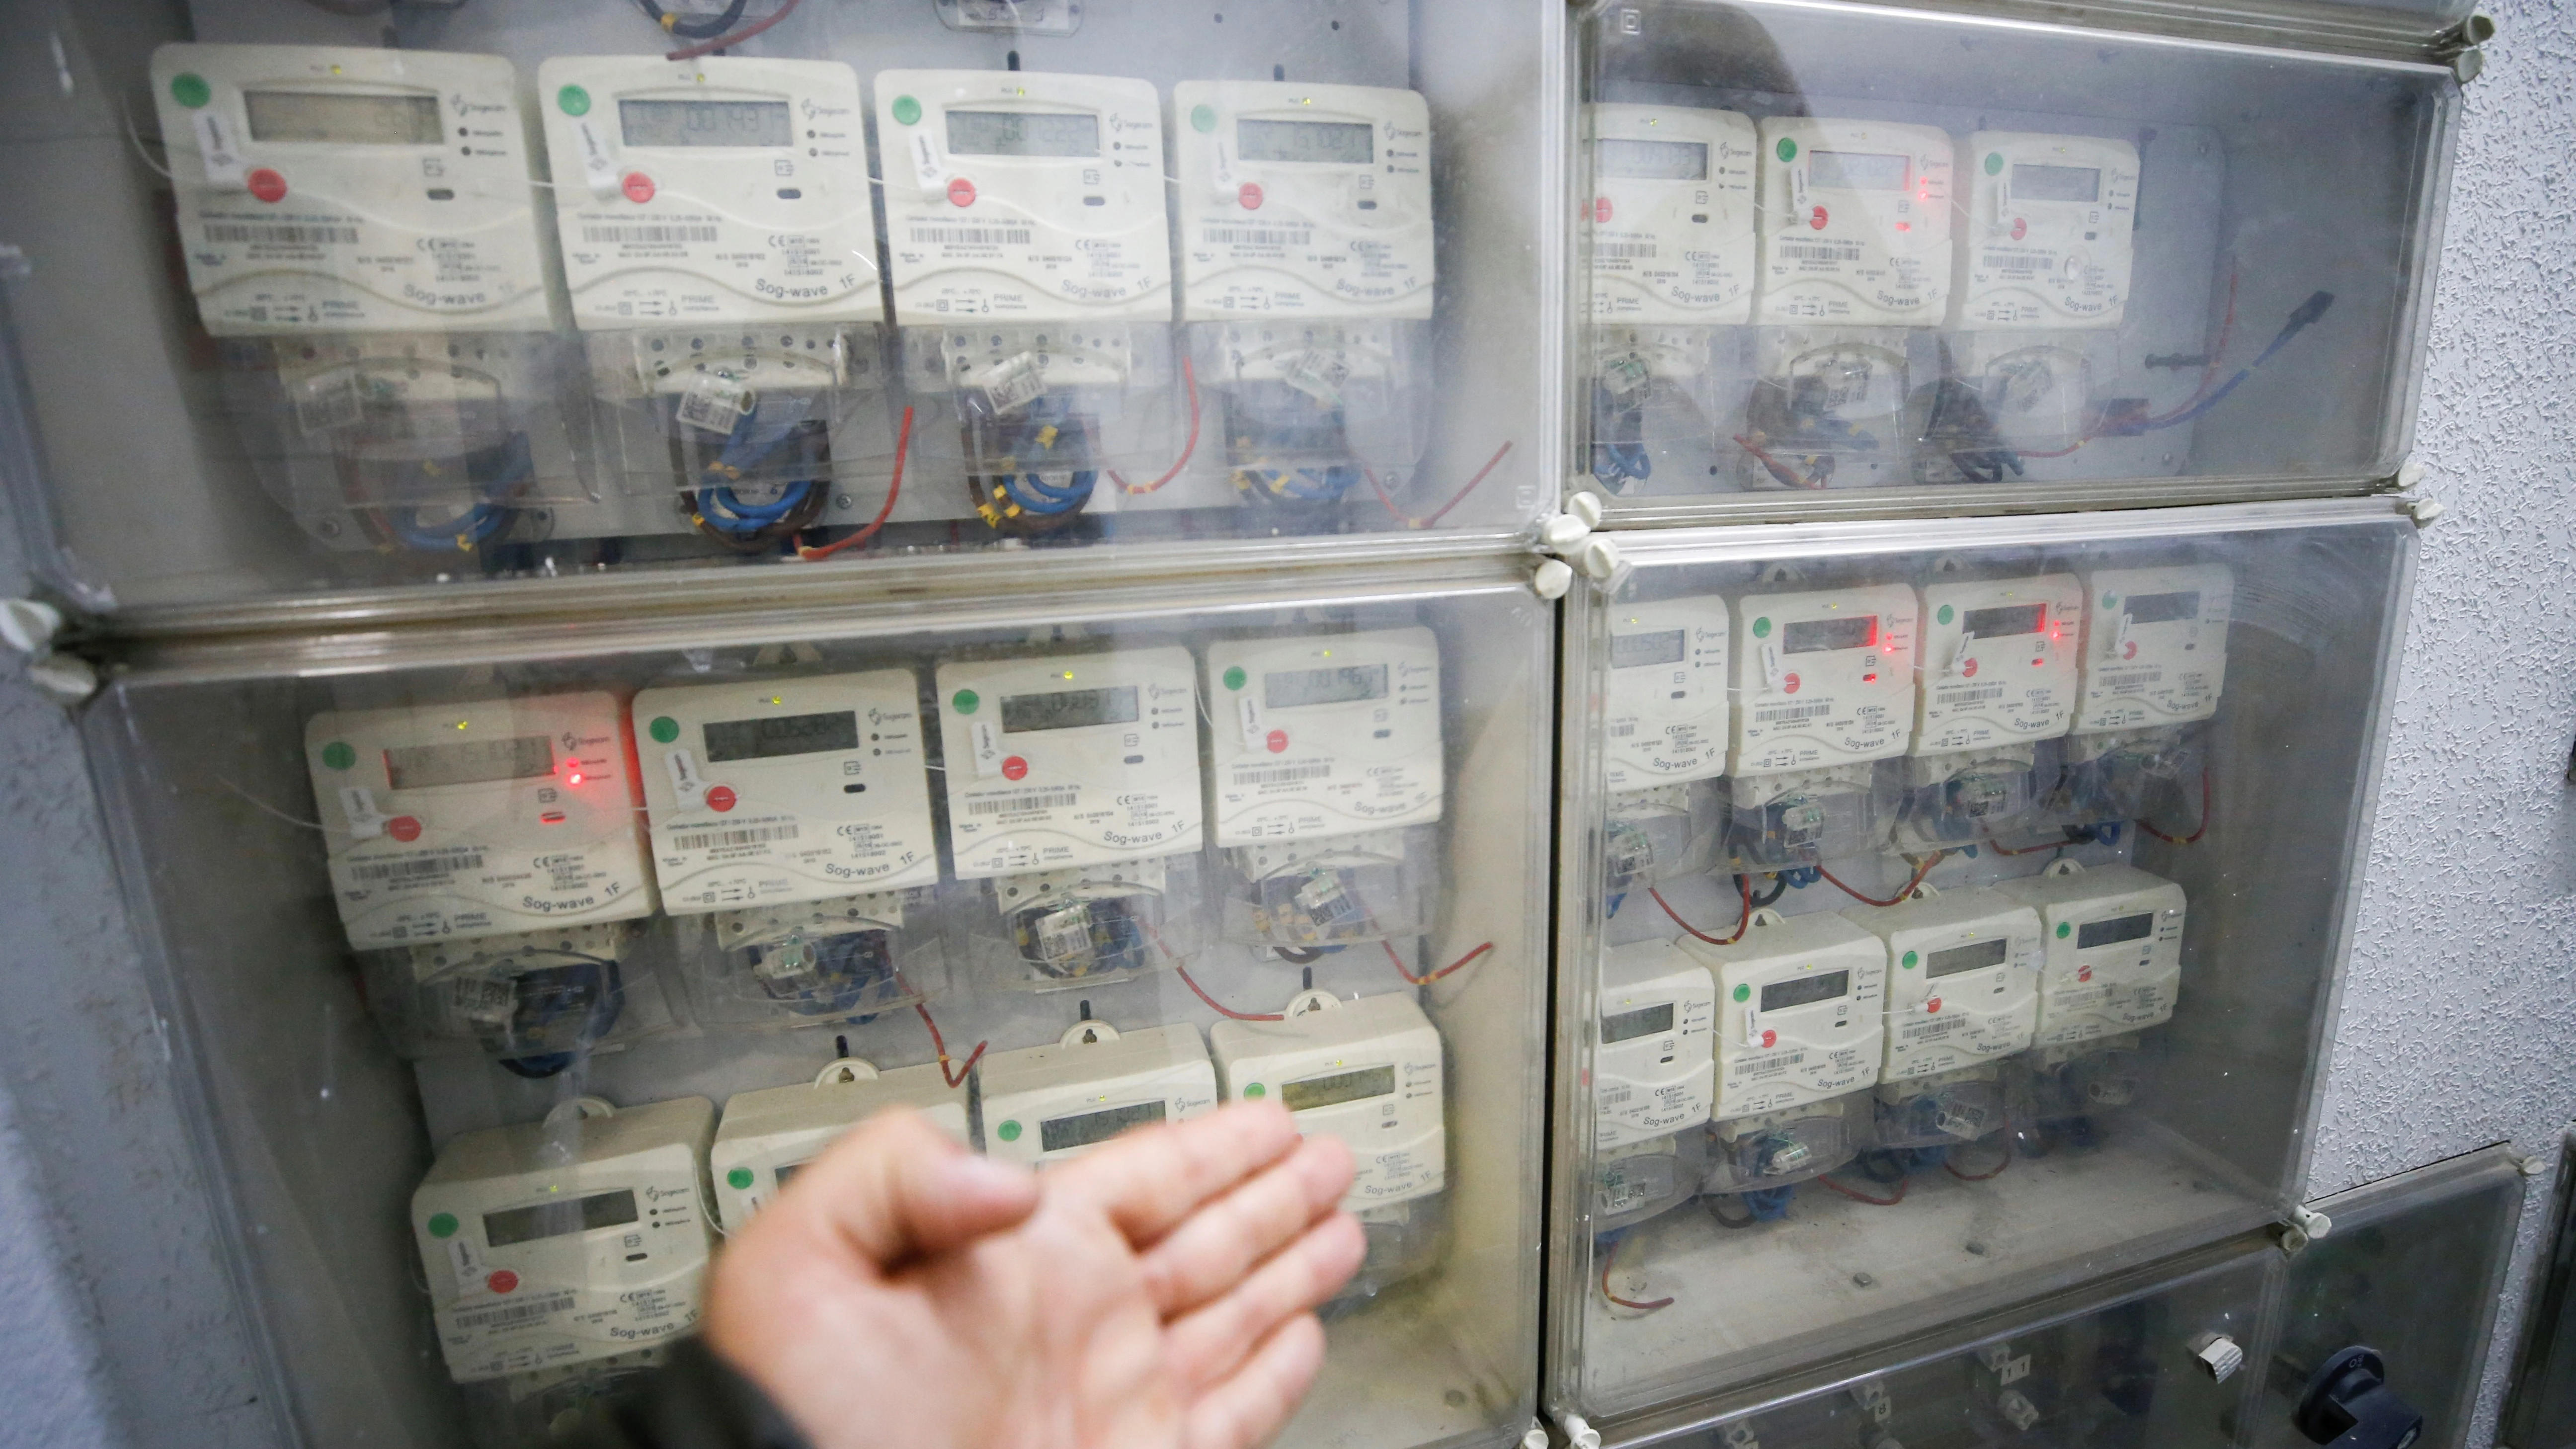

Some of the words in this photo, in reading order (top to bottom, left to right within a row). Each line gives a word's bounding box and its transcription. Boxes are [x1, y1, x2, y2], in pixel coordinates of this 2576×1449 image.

[403, 284, 486, 306] Sog-wave
[756, 278, 828, 298] Sog-wave
[839, 274, 856, 289] 1F
[1062, 279, 1126, 299] Sog-wave
[1137, 277, 1151, 290] 1F
[1336, 278, 1395, 297] Sog-wave
[1404, 277, 1417, 289] 1F
[1671, 286, 1720, 304] Sog-wave
[1728, 285, 1739, 296] 1F
[1877, 290, 1920, 306] Sog-wave
[1927, 288, 1938, 300] 1F
[2065, 296, 2101, 312] Sog-wave
[2109, 295, 2117, 306] 1F
[2167, 699, 2199, 711] Sog-wave
[2014, 718, 2049, 730] Sog-wave
[2056, 711, 2064, 721] 1F
[1845, 737, 1884, 750] Sog-wave
[1891, 729, 1901, 740] 1F
[1653, 757, 1697, 771] Sog-wave
[1705, 748, 1716, 759] 1F
[1355, 802, 1406, 815] Sog-wave
[1104, 831, 1162, 846] Sog-wave
[1171, 820, 1185, 832] 1F
[826, 862, 889, 877] Sog-wave
[899, 852, 915, 865] 1F
[523, 895, 594, 912] Sog-wave
[604, 883, 621, 895] 1F
[2122, 1012, 2154, 1022] Sog-wave
[1977, 1041, 2011, 1052] Sog-wave
[1817, 1076, 1854, 1089] Sog-wave
[1861, 1067, 1870, 1077] 1F
[1643, 1112, 1685, 1127] Sog-wave
[1691, 1103, 1701, 1113] 1F
[1365, 1183, 1412, 1195] Sog-wave
[1420, 1171, 1431, 1181] 1F
[610, 1321, 674, 1339] Sog-wave
[1878, 1403, 1886, 1415] 8
